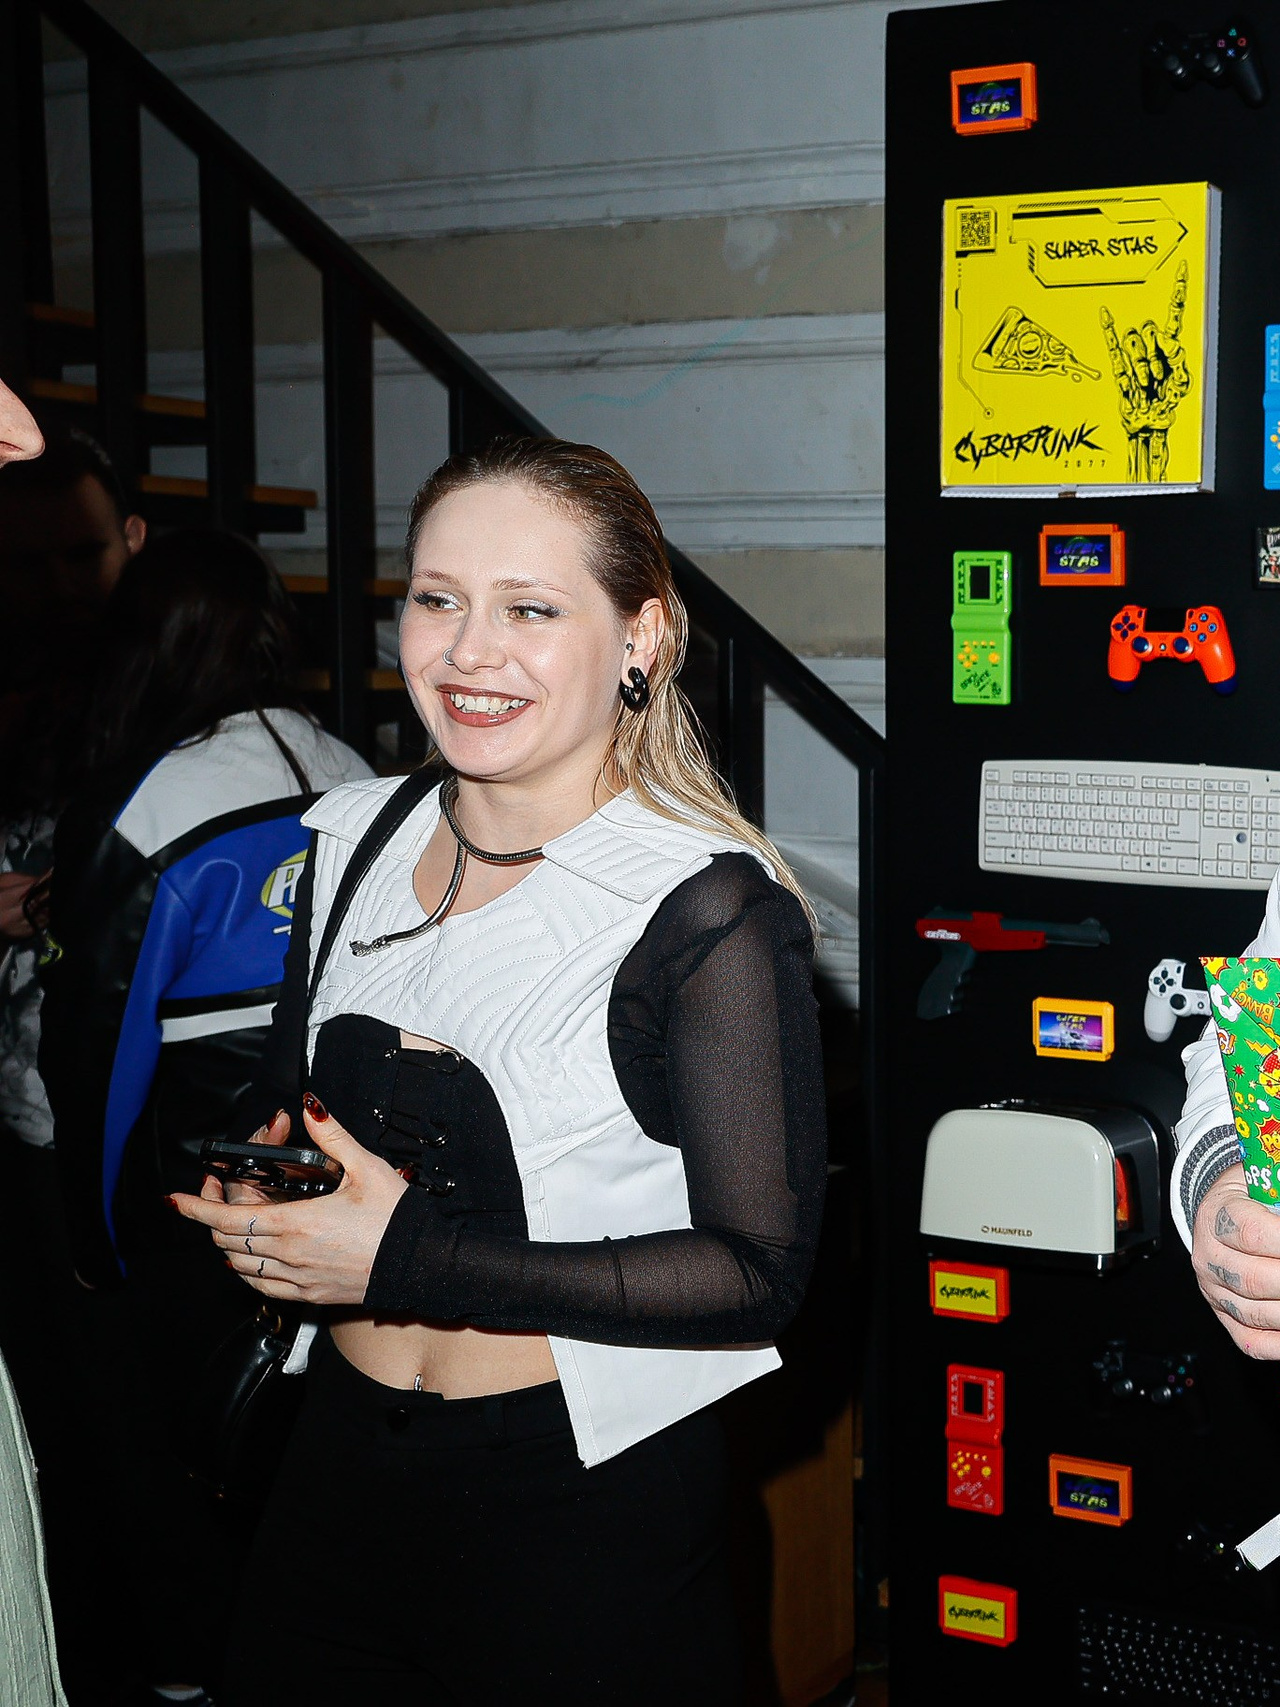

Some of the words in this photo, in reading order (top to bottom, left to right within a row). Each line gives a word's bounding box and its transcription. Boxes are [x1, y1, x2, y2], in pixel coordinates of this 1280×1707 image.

[1044, 239, 1105, 260] SUPER
[1107, 236, 1158, 256] STAS
[1059, 555, 1099, 567] STAS
[991, 1226, 1033, 1238] MAUNFELD
[1069, 1492, 1108, 1508] STAS
